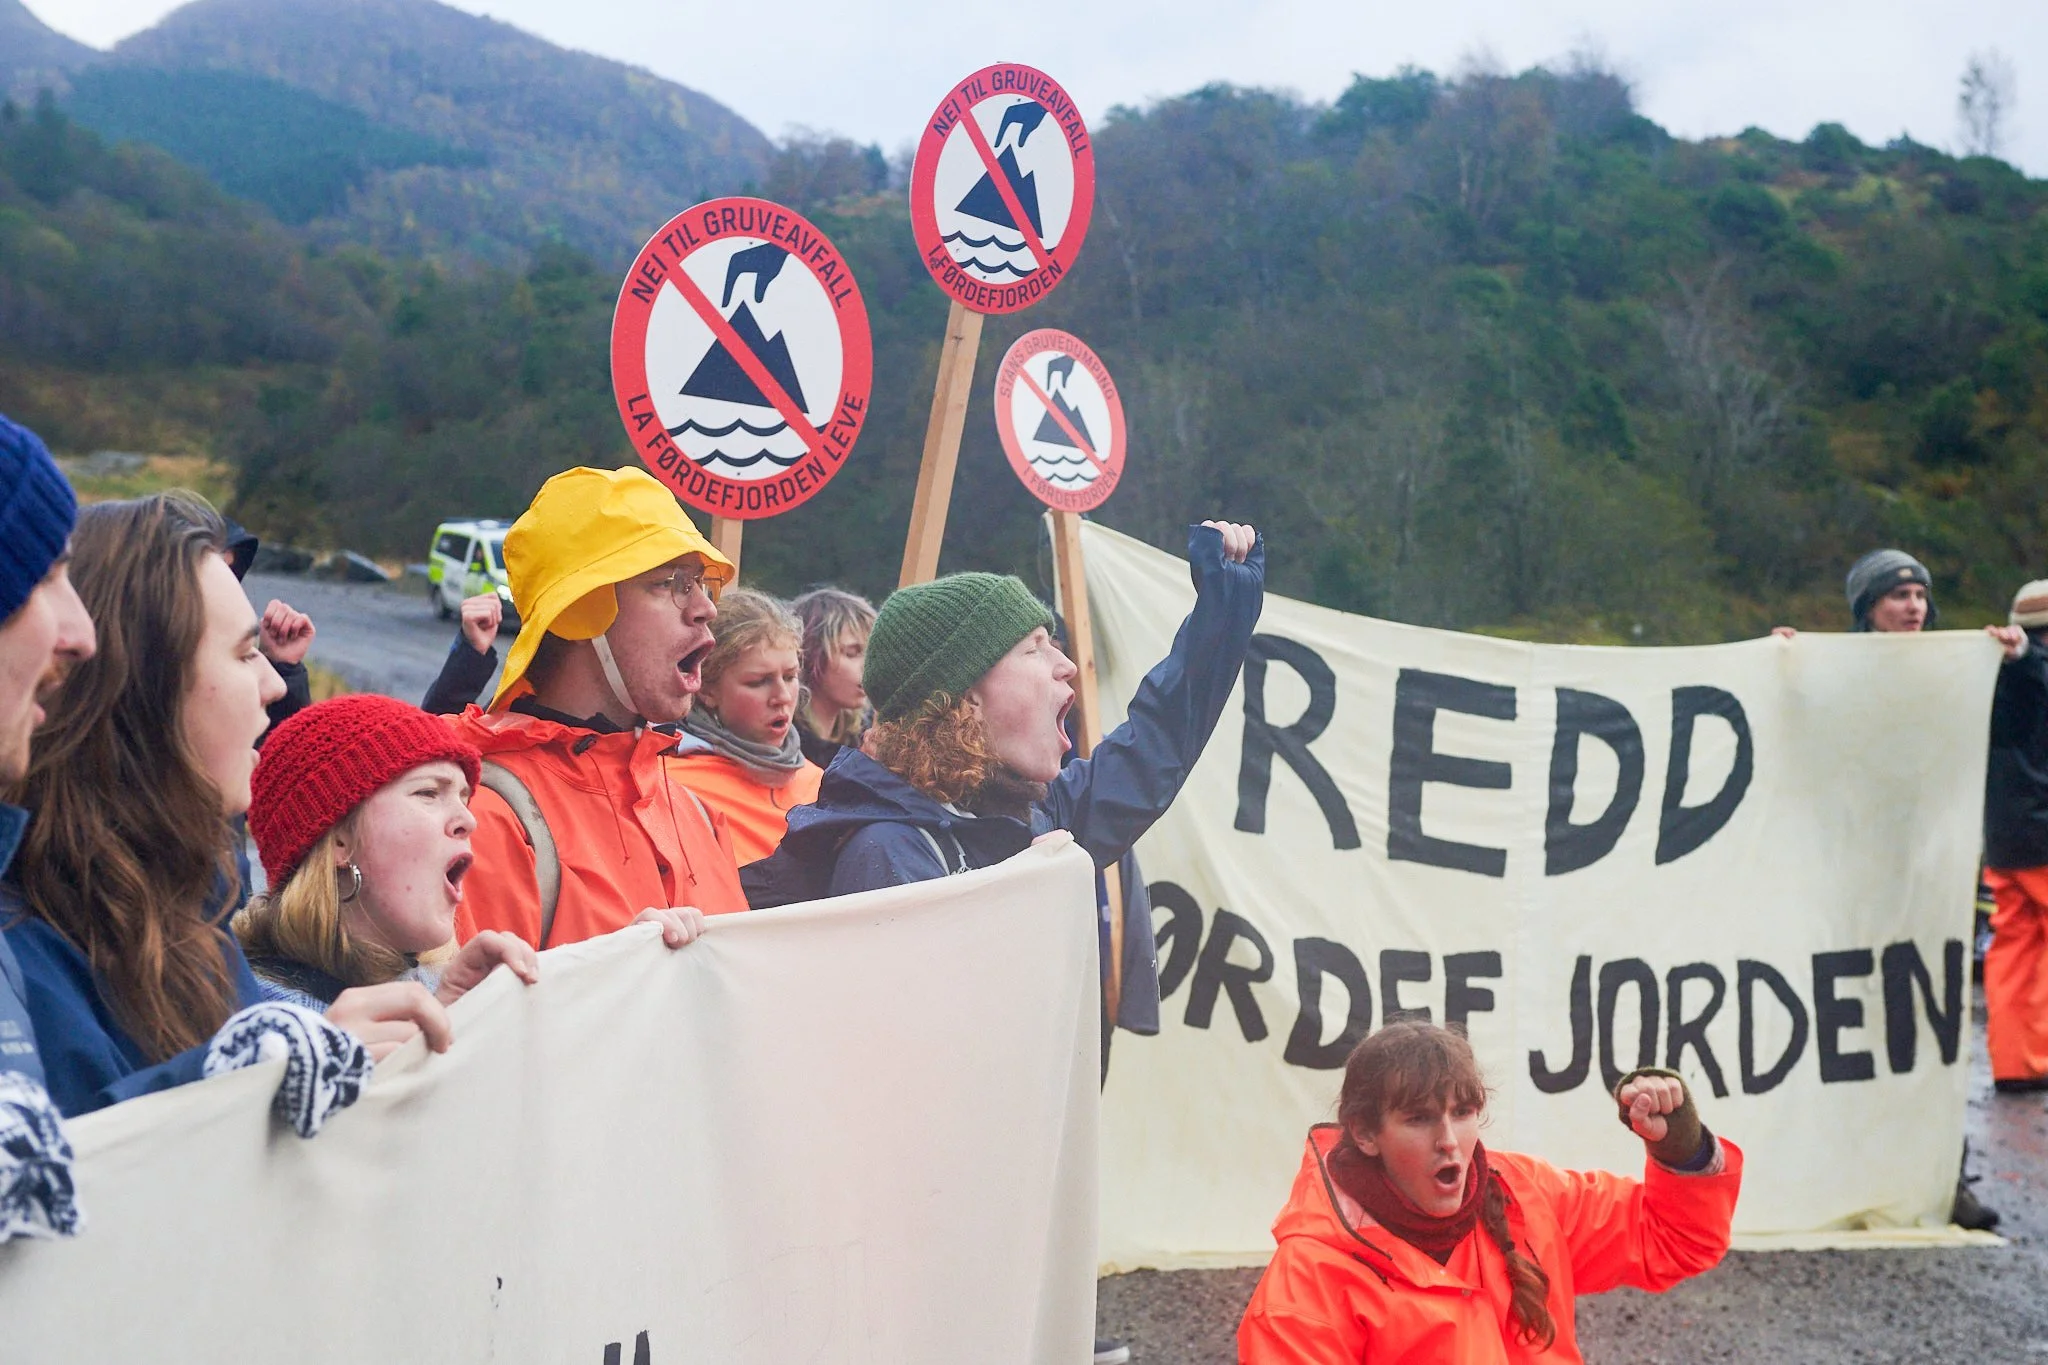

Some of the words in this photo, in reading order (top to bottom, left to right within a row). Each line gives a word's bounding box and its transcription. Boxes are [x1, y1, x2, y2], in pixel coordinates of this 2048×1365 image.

[933, 99, 961, 138] NEI
[960, 78, 987, 104] TIL
[991, 69, 1087, 159] GRUVEAVFALL
[631, 253, 668, 304] NEI
[662, 223, 700, 258] TIL
[703, 206, 852, 308] GRUVEAVFALL
[936, 255, 1063, 309] FØRDEFJORDEN
[628, 393, 655, 432] LA
[646, 435, 828, 511] FØRDEFJORDEN
[822, 395, 864, 462] LEVE
[1233, 633, 1754, 878] REDD
